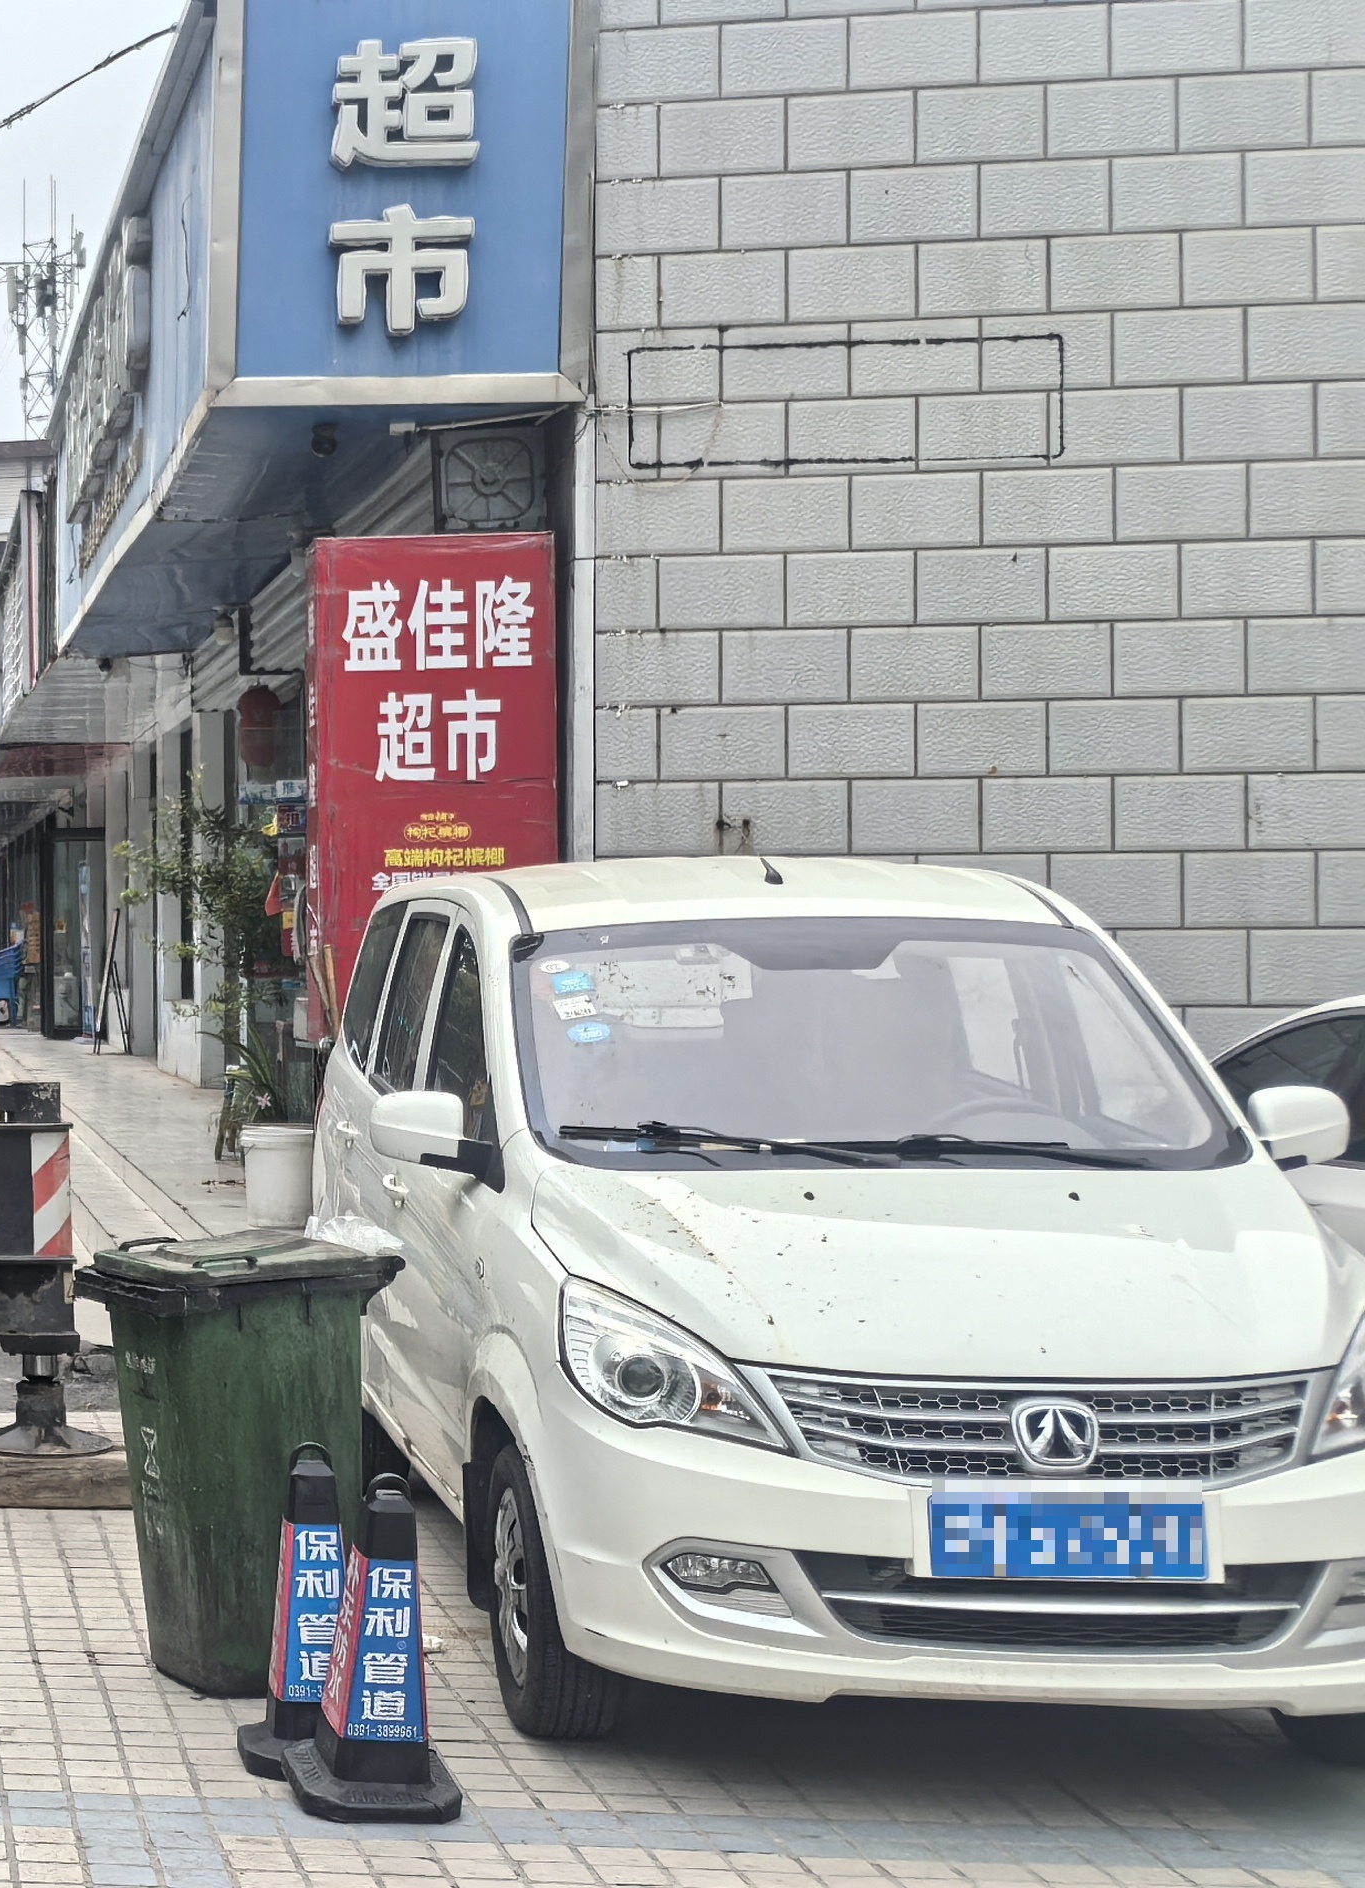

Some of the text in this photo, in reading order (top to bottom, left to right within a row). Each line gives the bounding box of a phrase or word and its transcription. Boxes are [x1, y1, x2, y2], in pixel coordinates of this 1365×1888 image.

[329, 37, 480, 337] 超市
[342, 575, 535, 671] 盛佳隆
[375, 689, 501, 782] 超市
[384, 847, 505, 867] 高端枸杞槟榔
[295, 1530, 340, 1681] 保利管道
[361, 1566, 413, 1721] 保利管道
